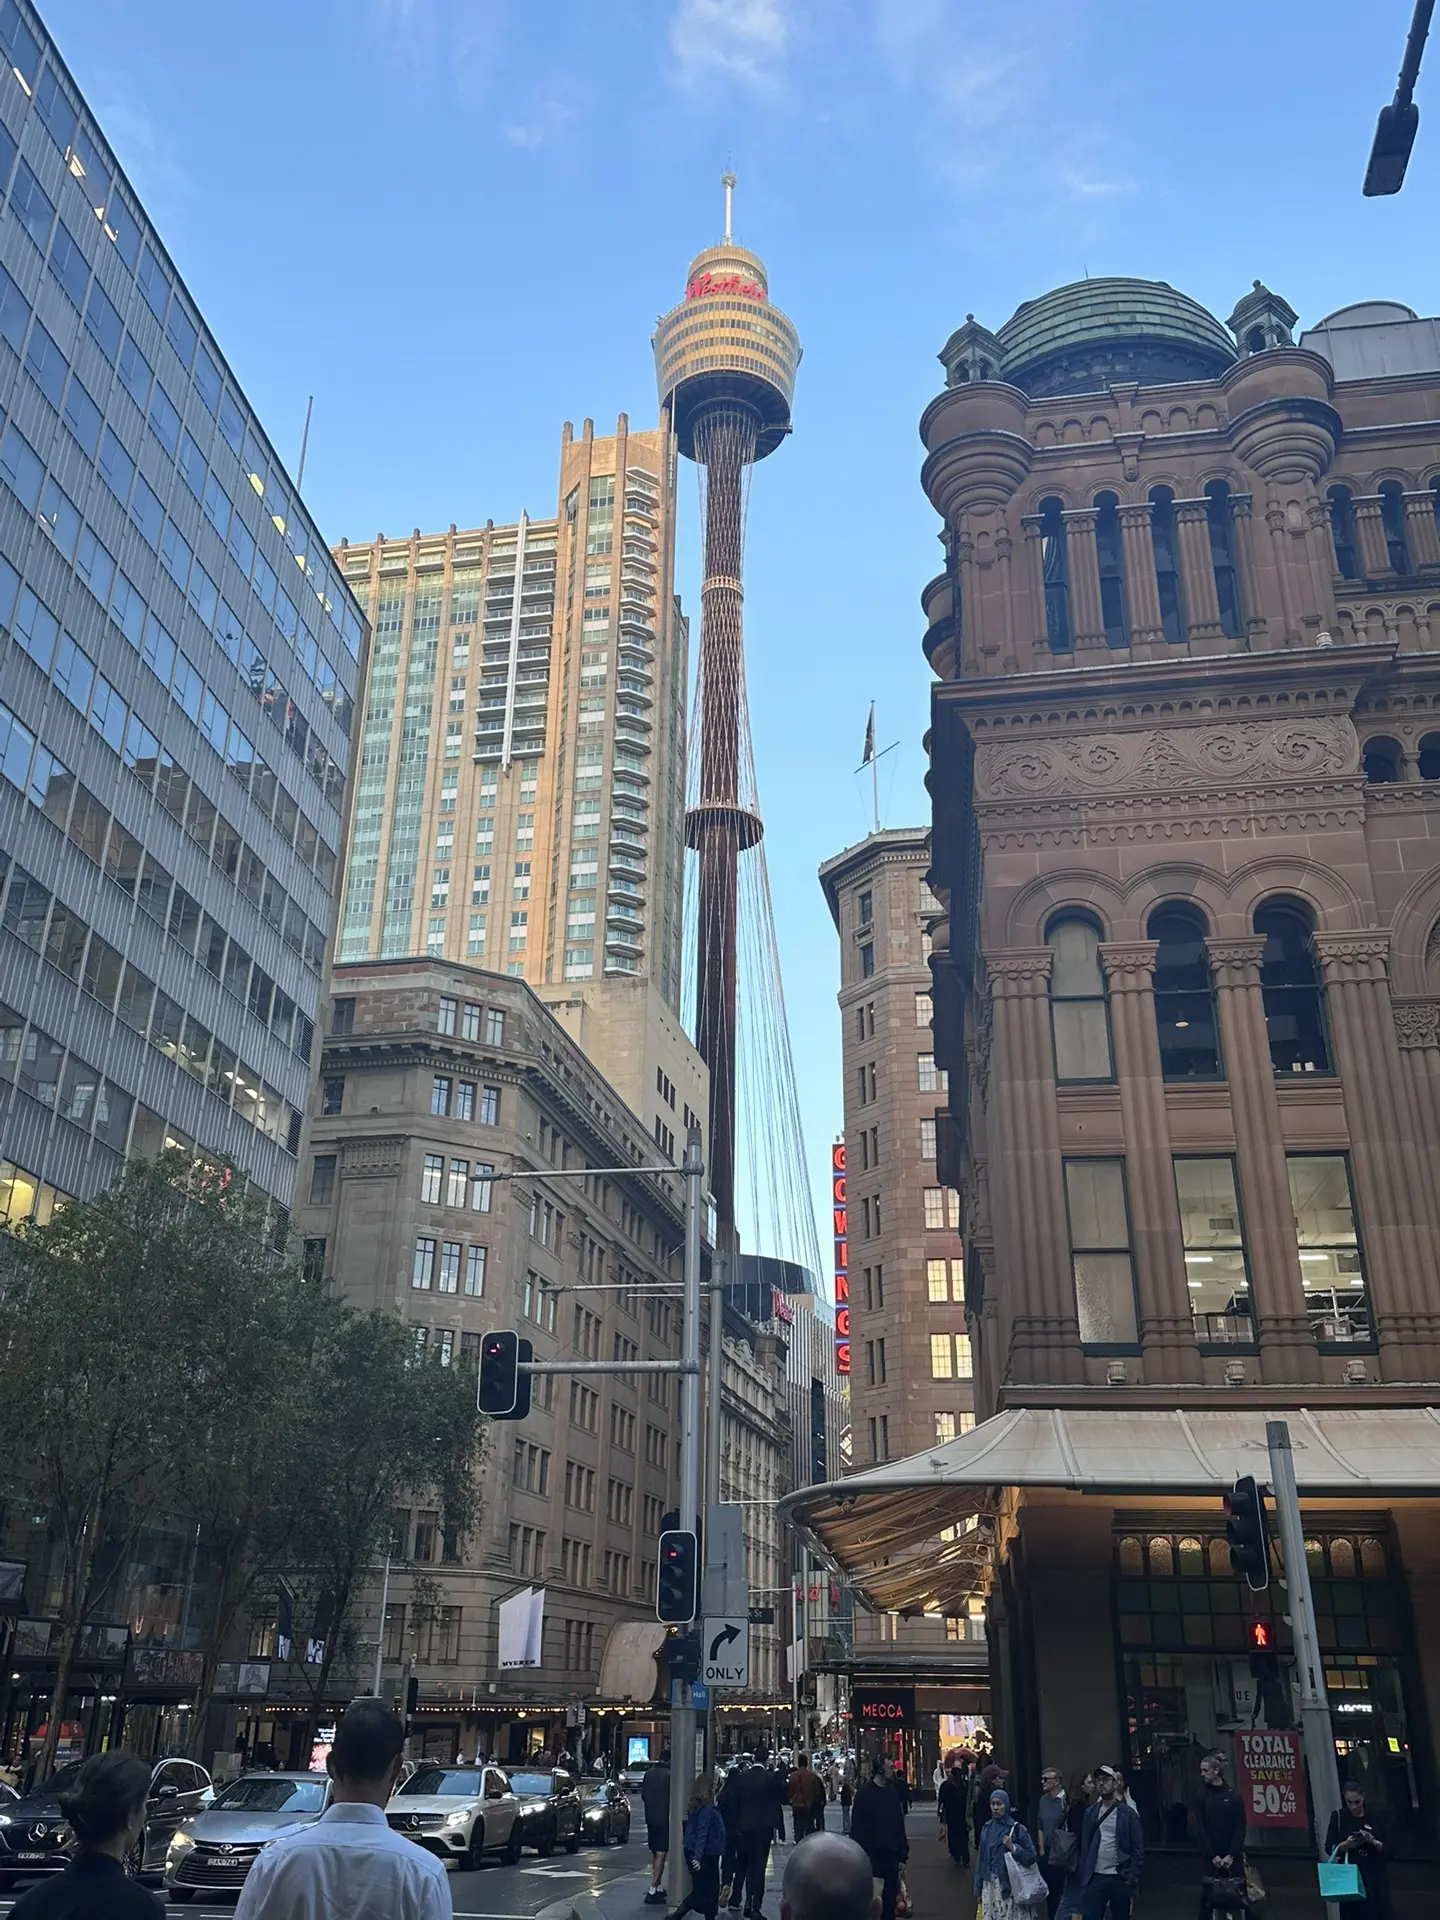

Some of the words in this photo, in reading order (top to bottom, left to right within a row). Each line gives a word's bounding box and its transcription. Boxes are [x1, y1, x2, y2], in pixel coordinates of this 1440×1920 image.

[686, 272, 766, 301] Westfield
[706, 1667, 744, 1680] ONLY
[862, 1703, 904, 1718] MECCA
[1241, 1735, 1294, 1753] TOTAL
[1243, 1754, 1296, 1769] CLEARANCE
[1250, 1770, 1281, 1780] SAVE
[1281, 1801, 1297, 1813] OFF
